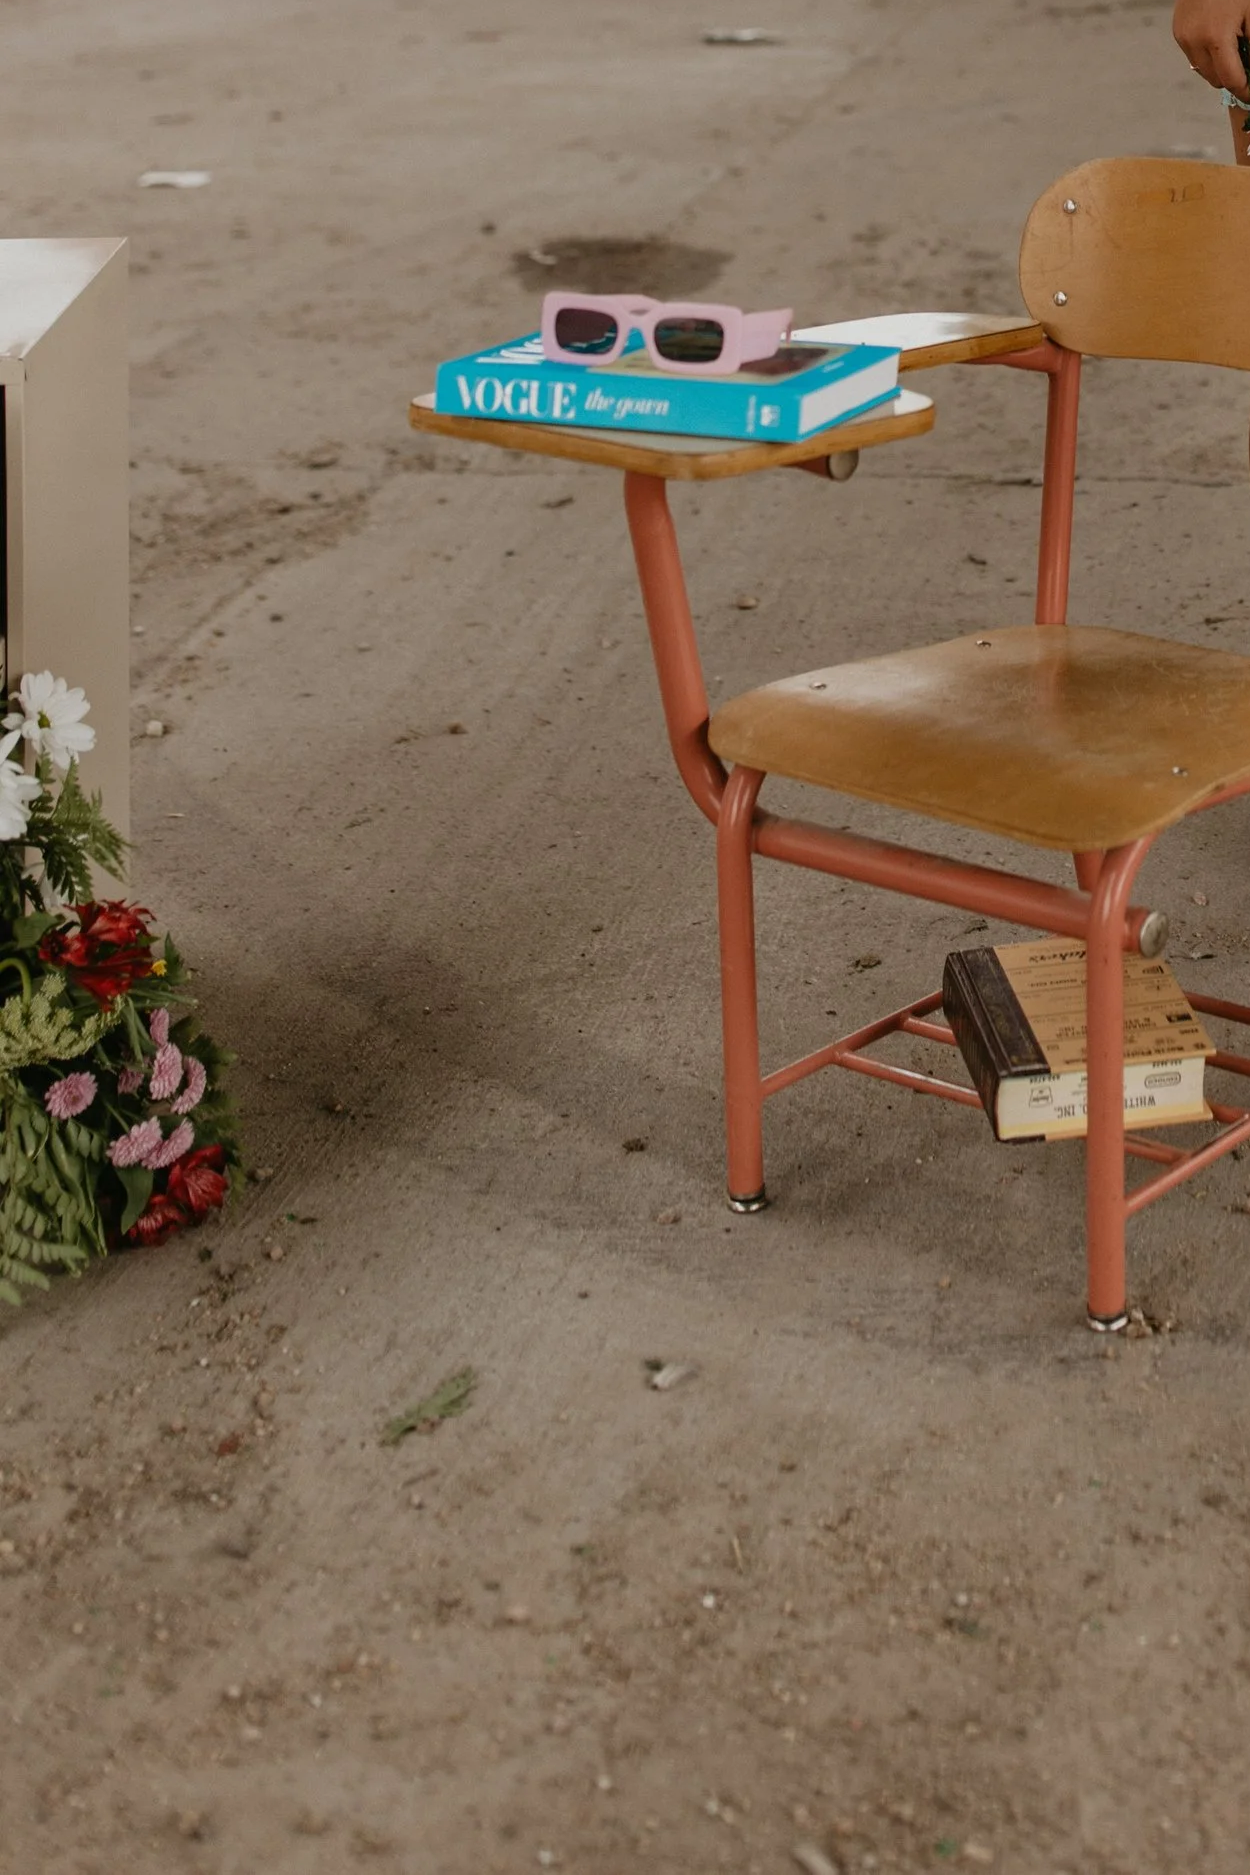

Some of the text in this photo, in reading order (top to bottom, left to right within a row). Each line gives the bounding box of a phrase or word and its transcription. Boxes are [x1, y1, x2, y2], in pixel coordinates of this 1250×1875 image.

[456, 375, 670, 420] VOGUE the gown
[1054, 1104, 1076, 1119] INC.
